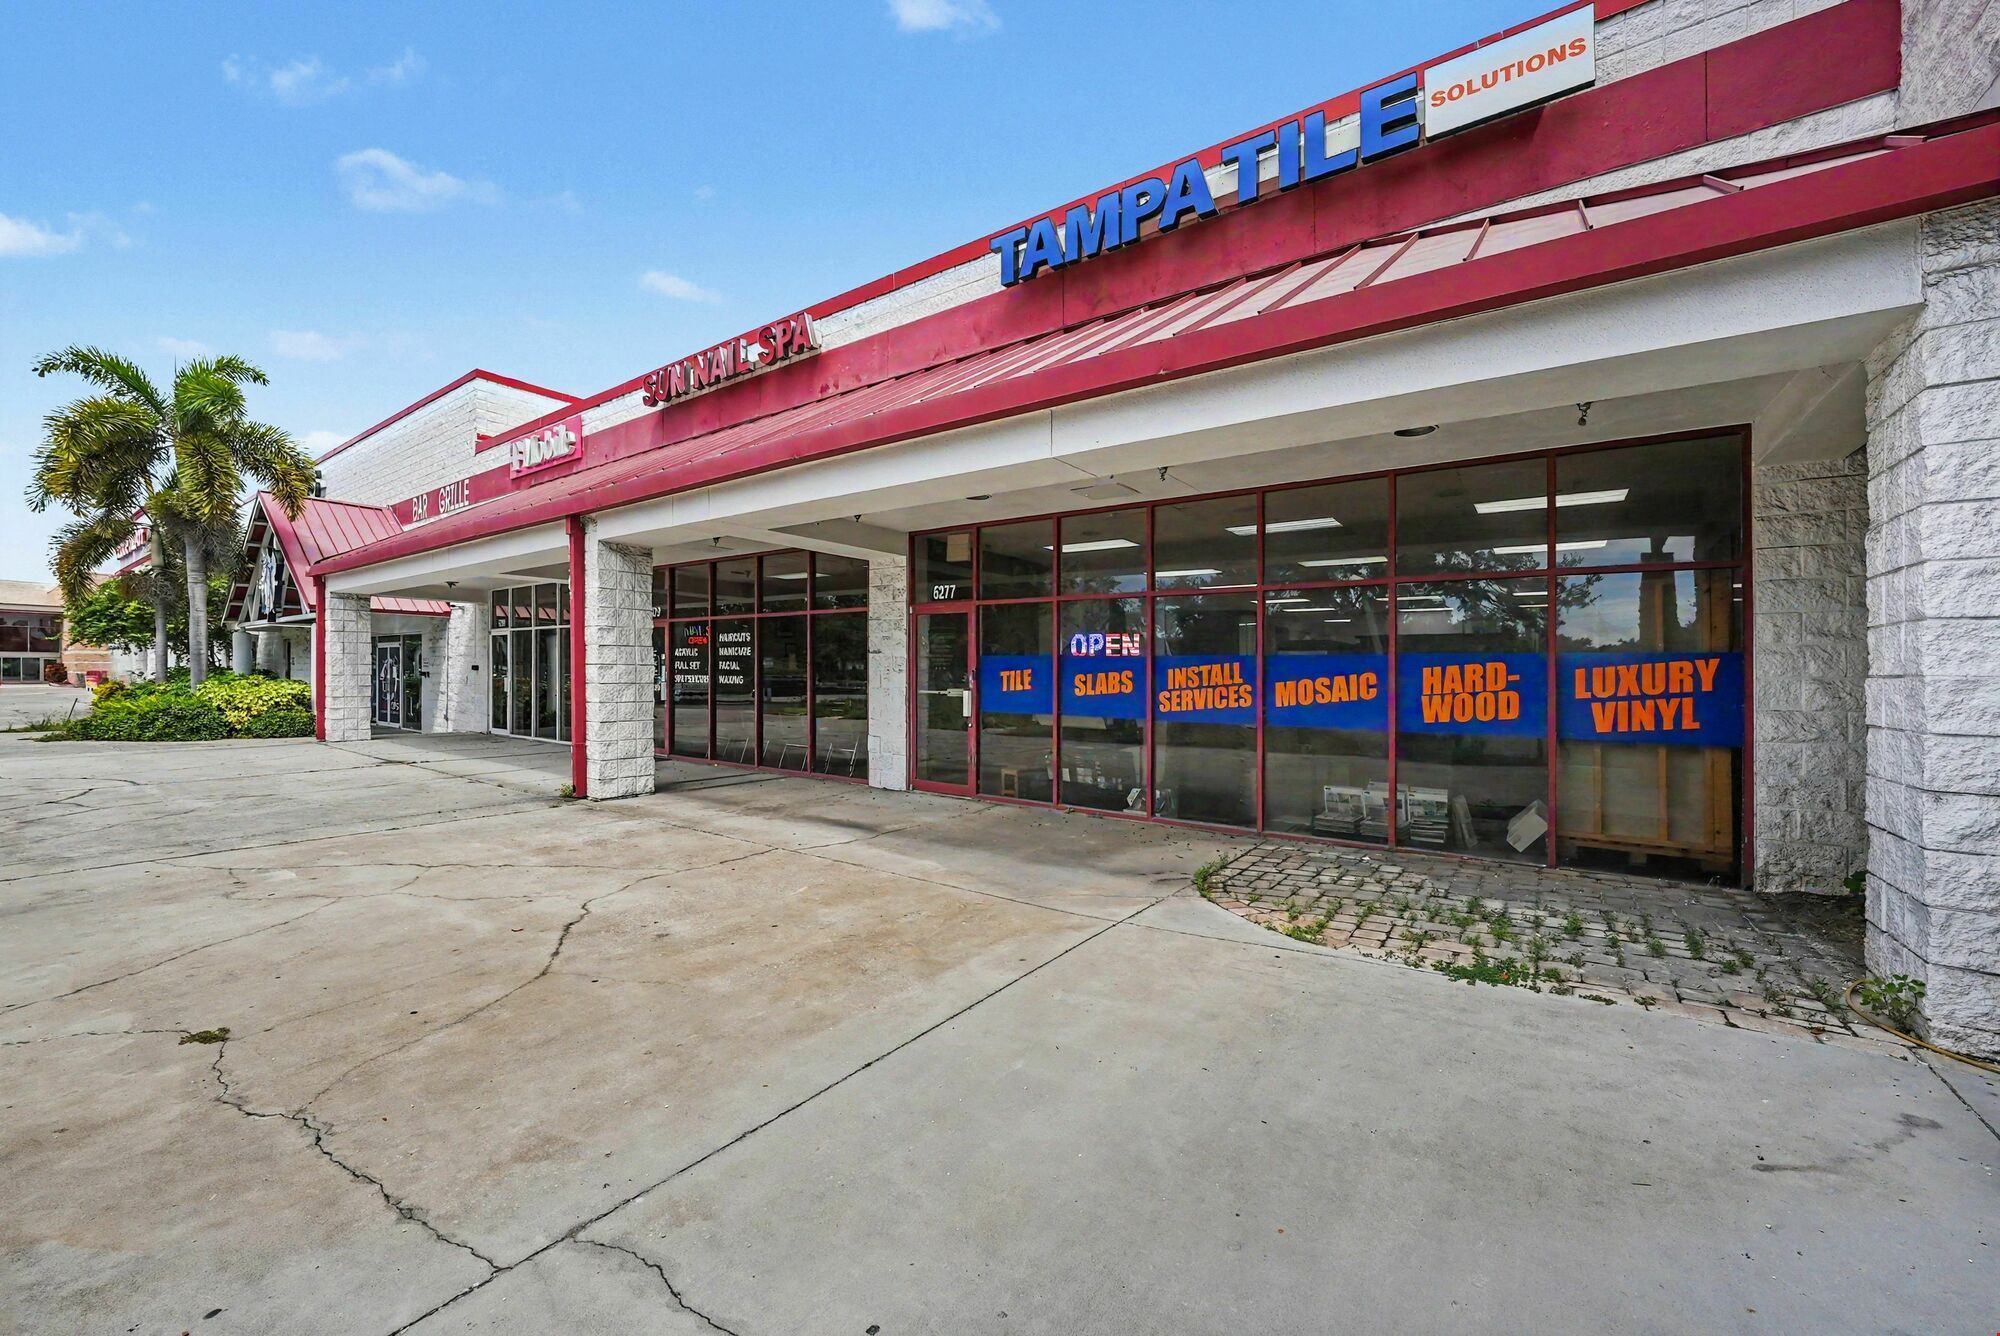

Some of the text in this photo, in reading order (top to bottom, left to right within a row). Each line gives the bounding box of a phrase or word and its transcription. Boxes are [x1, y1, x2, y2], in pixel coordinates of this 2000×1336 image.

[1431, 38, 1586, 107] SOLUTIONS
[990, 72, 1420, 287] TAMPA TILE
[643, 312, 819, 407] SUN NAIL SPA
[412, 479, 470, 521] BAR GRILLE
[933, 584, 956, 600] 6277
[719, 632, 751, 642] HAIRCUTS
[1070, 633, 1140, 657] OPEN
[1000, 668, 1032, 692] TILE
[1074, 670, 1134, 697] SLABS
[1167, 661, 1244, 690] INSTALL
[1274, 671, 1379, 708] MOSAIC
[1422, 662, 1521, 695] HARD-
[1574, 658, 1721, 699] LUXURY
[1158, 684, 1254, 713] SERVICES
[1421, 690, 1520, 724] WOOD
[1591, 697, 1701, 734] VINYL
